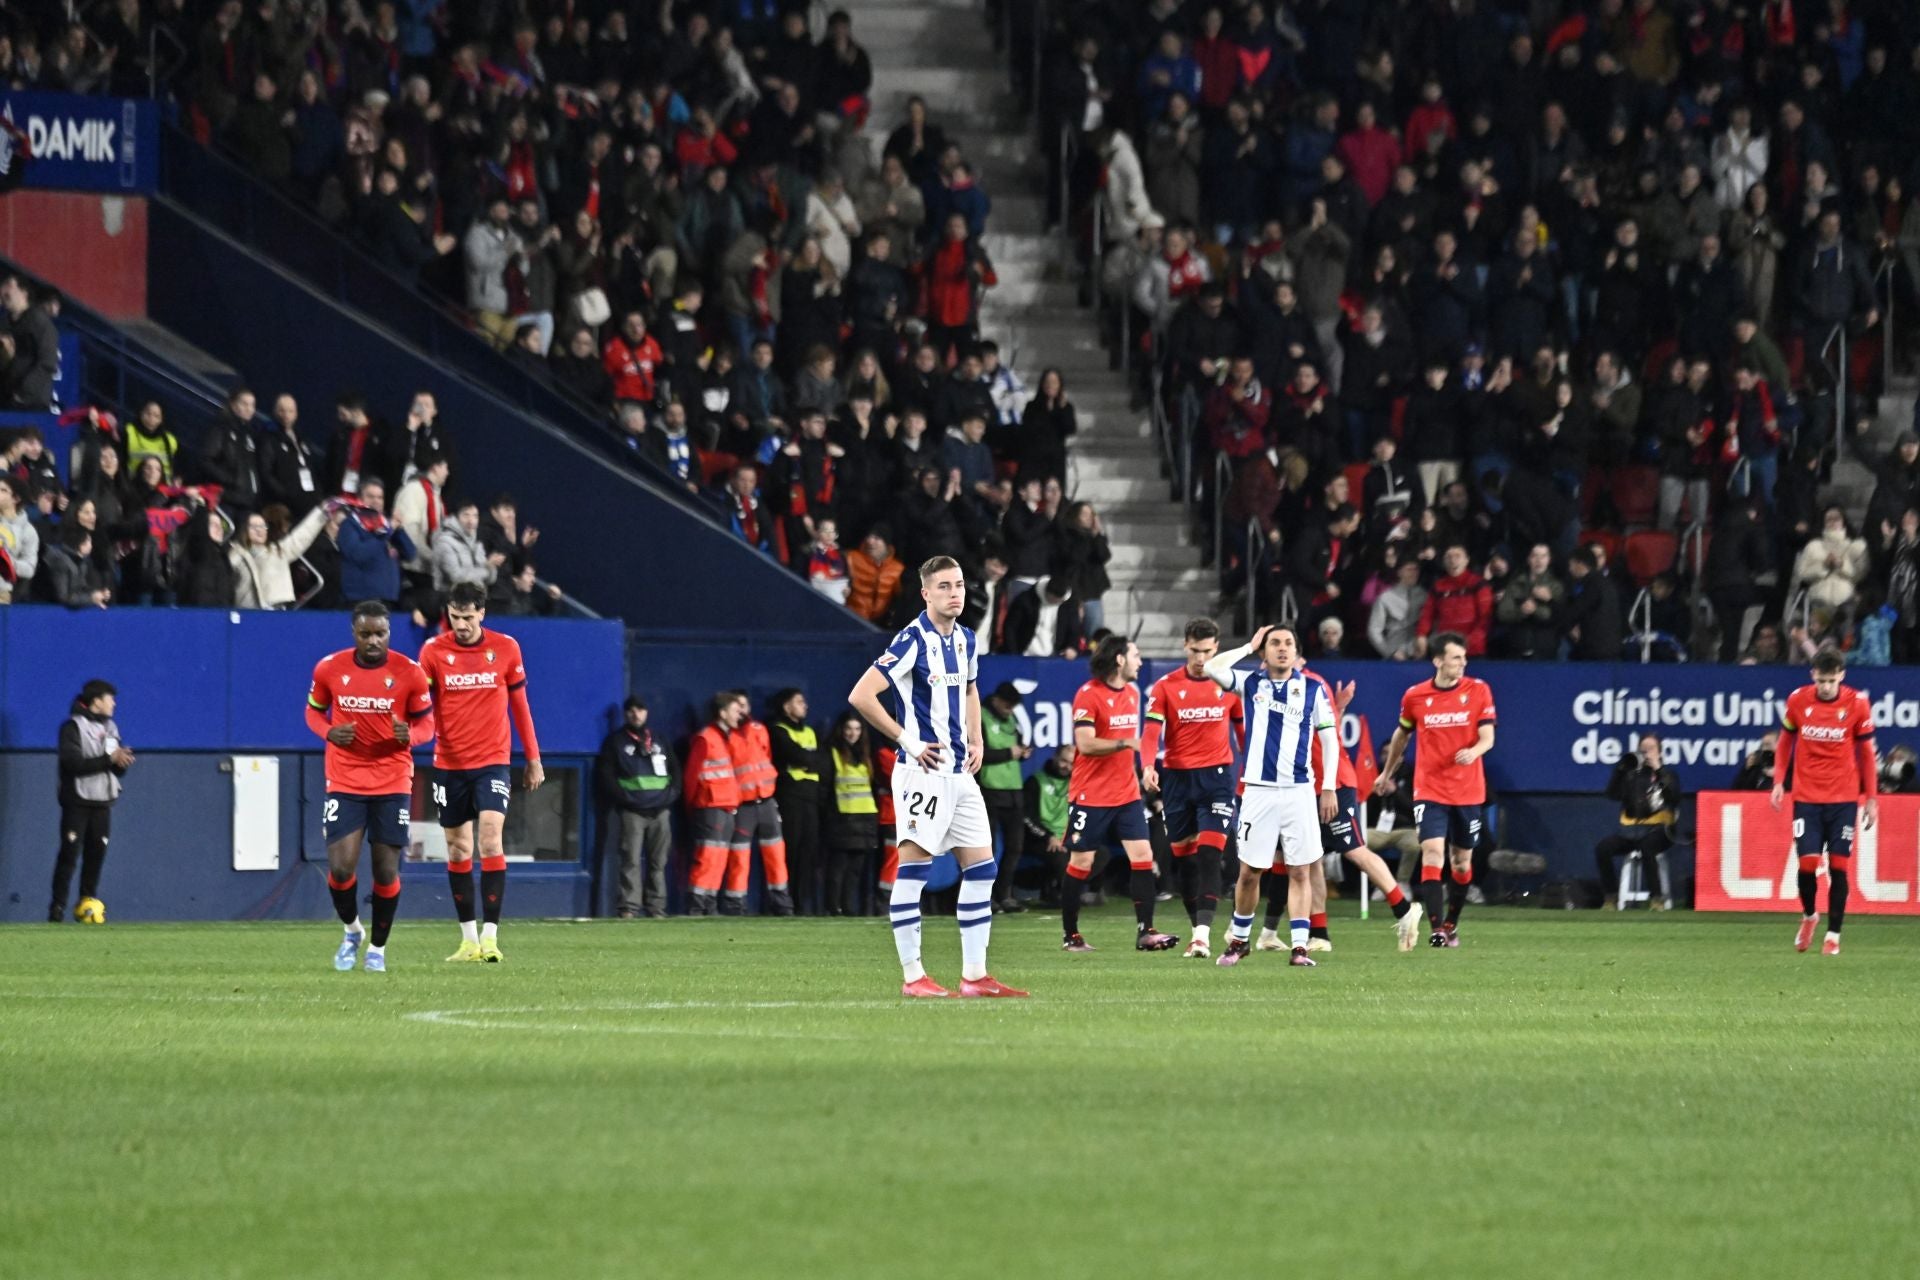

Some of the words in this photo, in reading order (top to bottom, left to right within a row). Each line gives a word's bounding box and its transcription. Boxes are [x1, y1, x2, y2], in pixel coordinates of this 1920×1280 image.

[28, 115, 116, 163] DAMIK
[1573, 687, 1706, 726] Clínica
[1571, 729, 1622, 765] de
[909, 791, 938, 820] 24
[1720, 803, 1920, 903] LL
